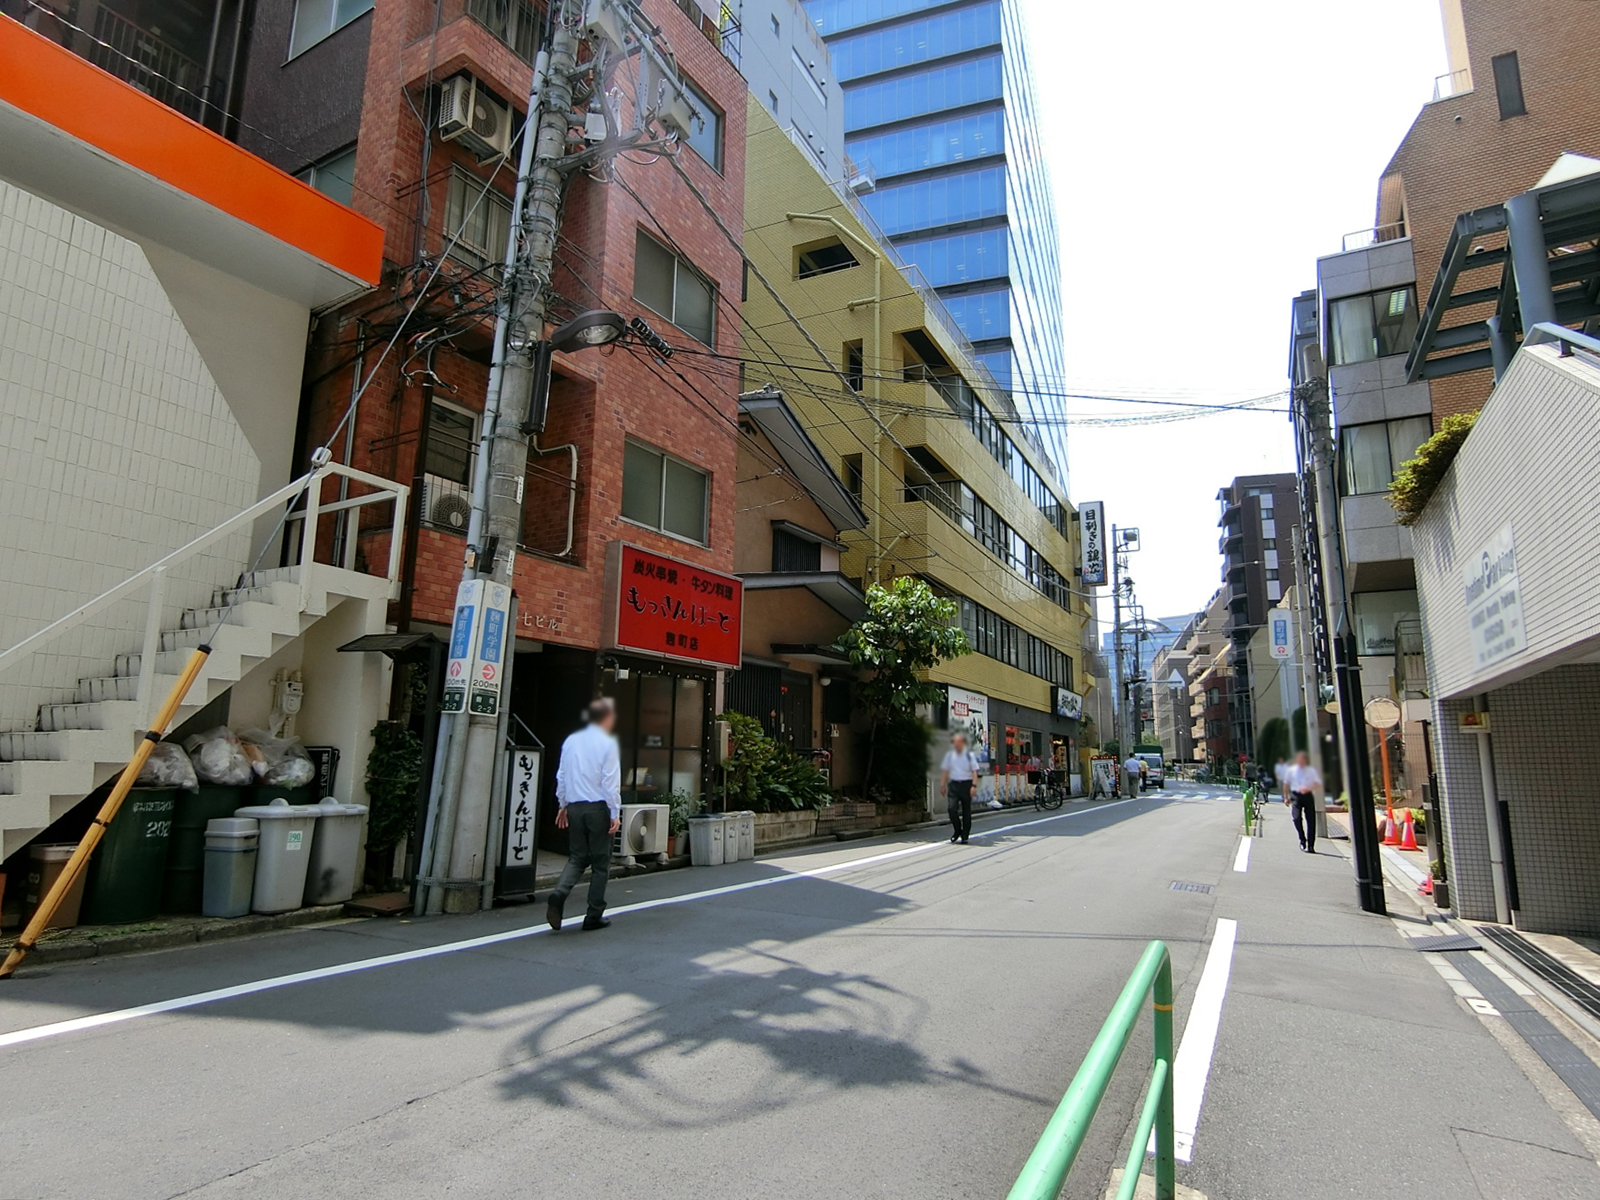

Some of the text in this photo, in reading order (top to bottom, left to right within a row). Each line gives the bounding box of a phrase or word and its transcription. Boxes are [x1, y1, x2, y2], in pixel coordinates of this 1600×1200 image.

[1085, 509, 1101, 574] 目利きの銀次
[516, 612, 559, 629] 七ビル
[626, 586, 735, 632] もっきんばーど
[477, 704, 492, 713] 2-2
[512, 754, 534, 860] もっきんばーど
